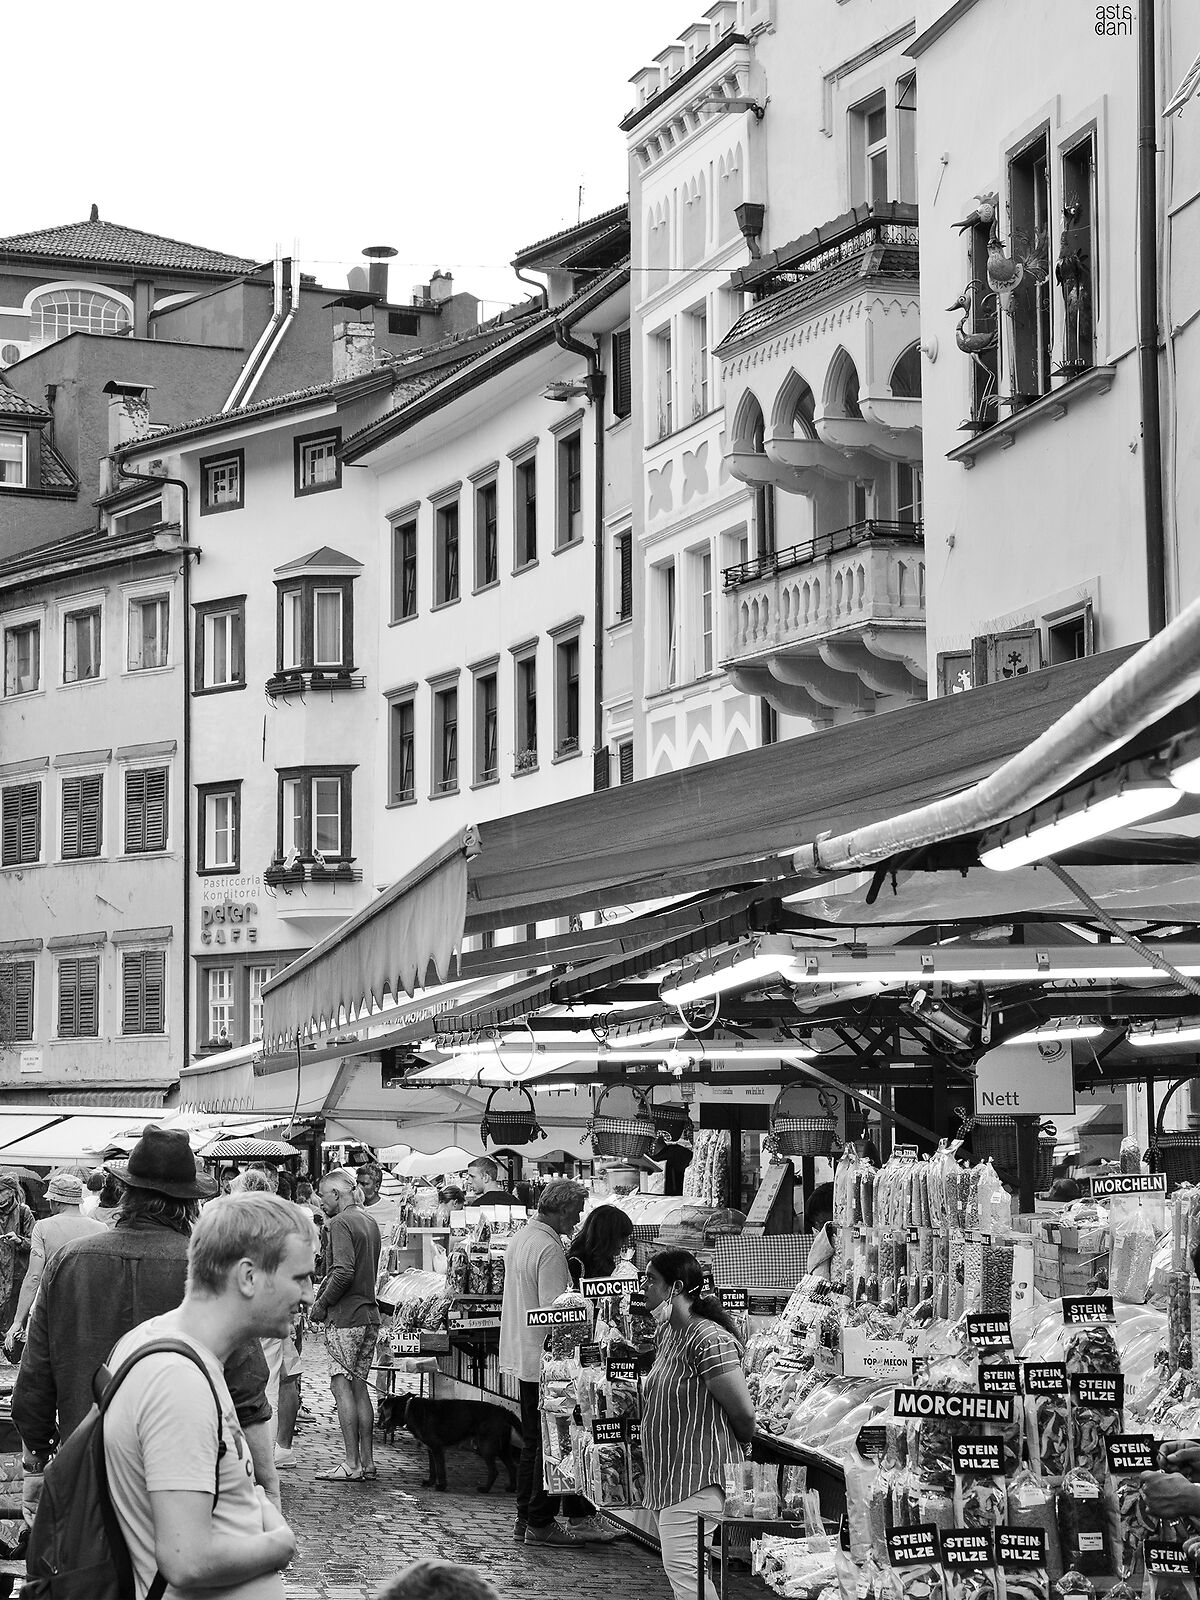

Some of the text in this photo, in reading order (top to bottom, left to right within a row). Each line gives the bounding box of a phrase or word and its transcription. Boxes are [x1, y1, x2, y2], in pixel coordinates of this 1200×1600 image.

[203, 875, 261, 888] Pasticceria
[203, 887, 261, 901] Konditorei
[201, 899, 258, 930] peter
[982, 1091, 1020, 1106] Nett
[1094, 1177, 1163, 1194] MORCHELN
[585, 1280, 640, 1296] MORCHEL
[1070, 1304, 1106, 1314] STEIN
[529, 1310, 586, 1325] MORCHELN
[1071, 1313, 1108, 1323] PILZE
[969, 1322, 1009, 1334] STEIN
[971, 1335, 1011, 1346] PILZE
[610, 1362, 635, 1370] STEIN
[863, 1357, 878, 1366] TOP
[983, 1371, 1015, 1380] STEIN
[1029, 1368, 1061, 1378] STEIN
[984, 1382, 1016, 1391] PILZE
[1030, 1379, 1063, 1389] PILZE
[1078, 1380, 1116, 1390] STEIN
[1079, 1390, 1116, 1401] PILZE
[897, 1393, 1009, 1419] MORCHELN
[596, 1422, 621, 1431] STEIN
[596, 1431, 622, 1440] PILZE
[957, 1444, 998, 1455] STEIN
[1111, 1442, 1150, 1454] STEIN
[959, 1458, 1000, 1469] PILZE
[1113, 1457, 1153, 1467] PILZE
[892, 1532, 933, 1546] STEIN
[945, 1536, 987, 1548] STEIN
[1000, 1534, 1040, 1546] STEIN
[894, 1546, 935, 1560] PILZE
[947, 1551, 988, 1562] PILZE
[1001, 1549, 1040, 1561] PILZE
[1150, 1549, 1187, 1561] STEIN
[1151, 1562, 1191, 1574] PILZE
